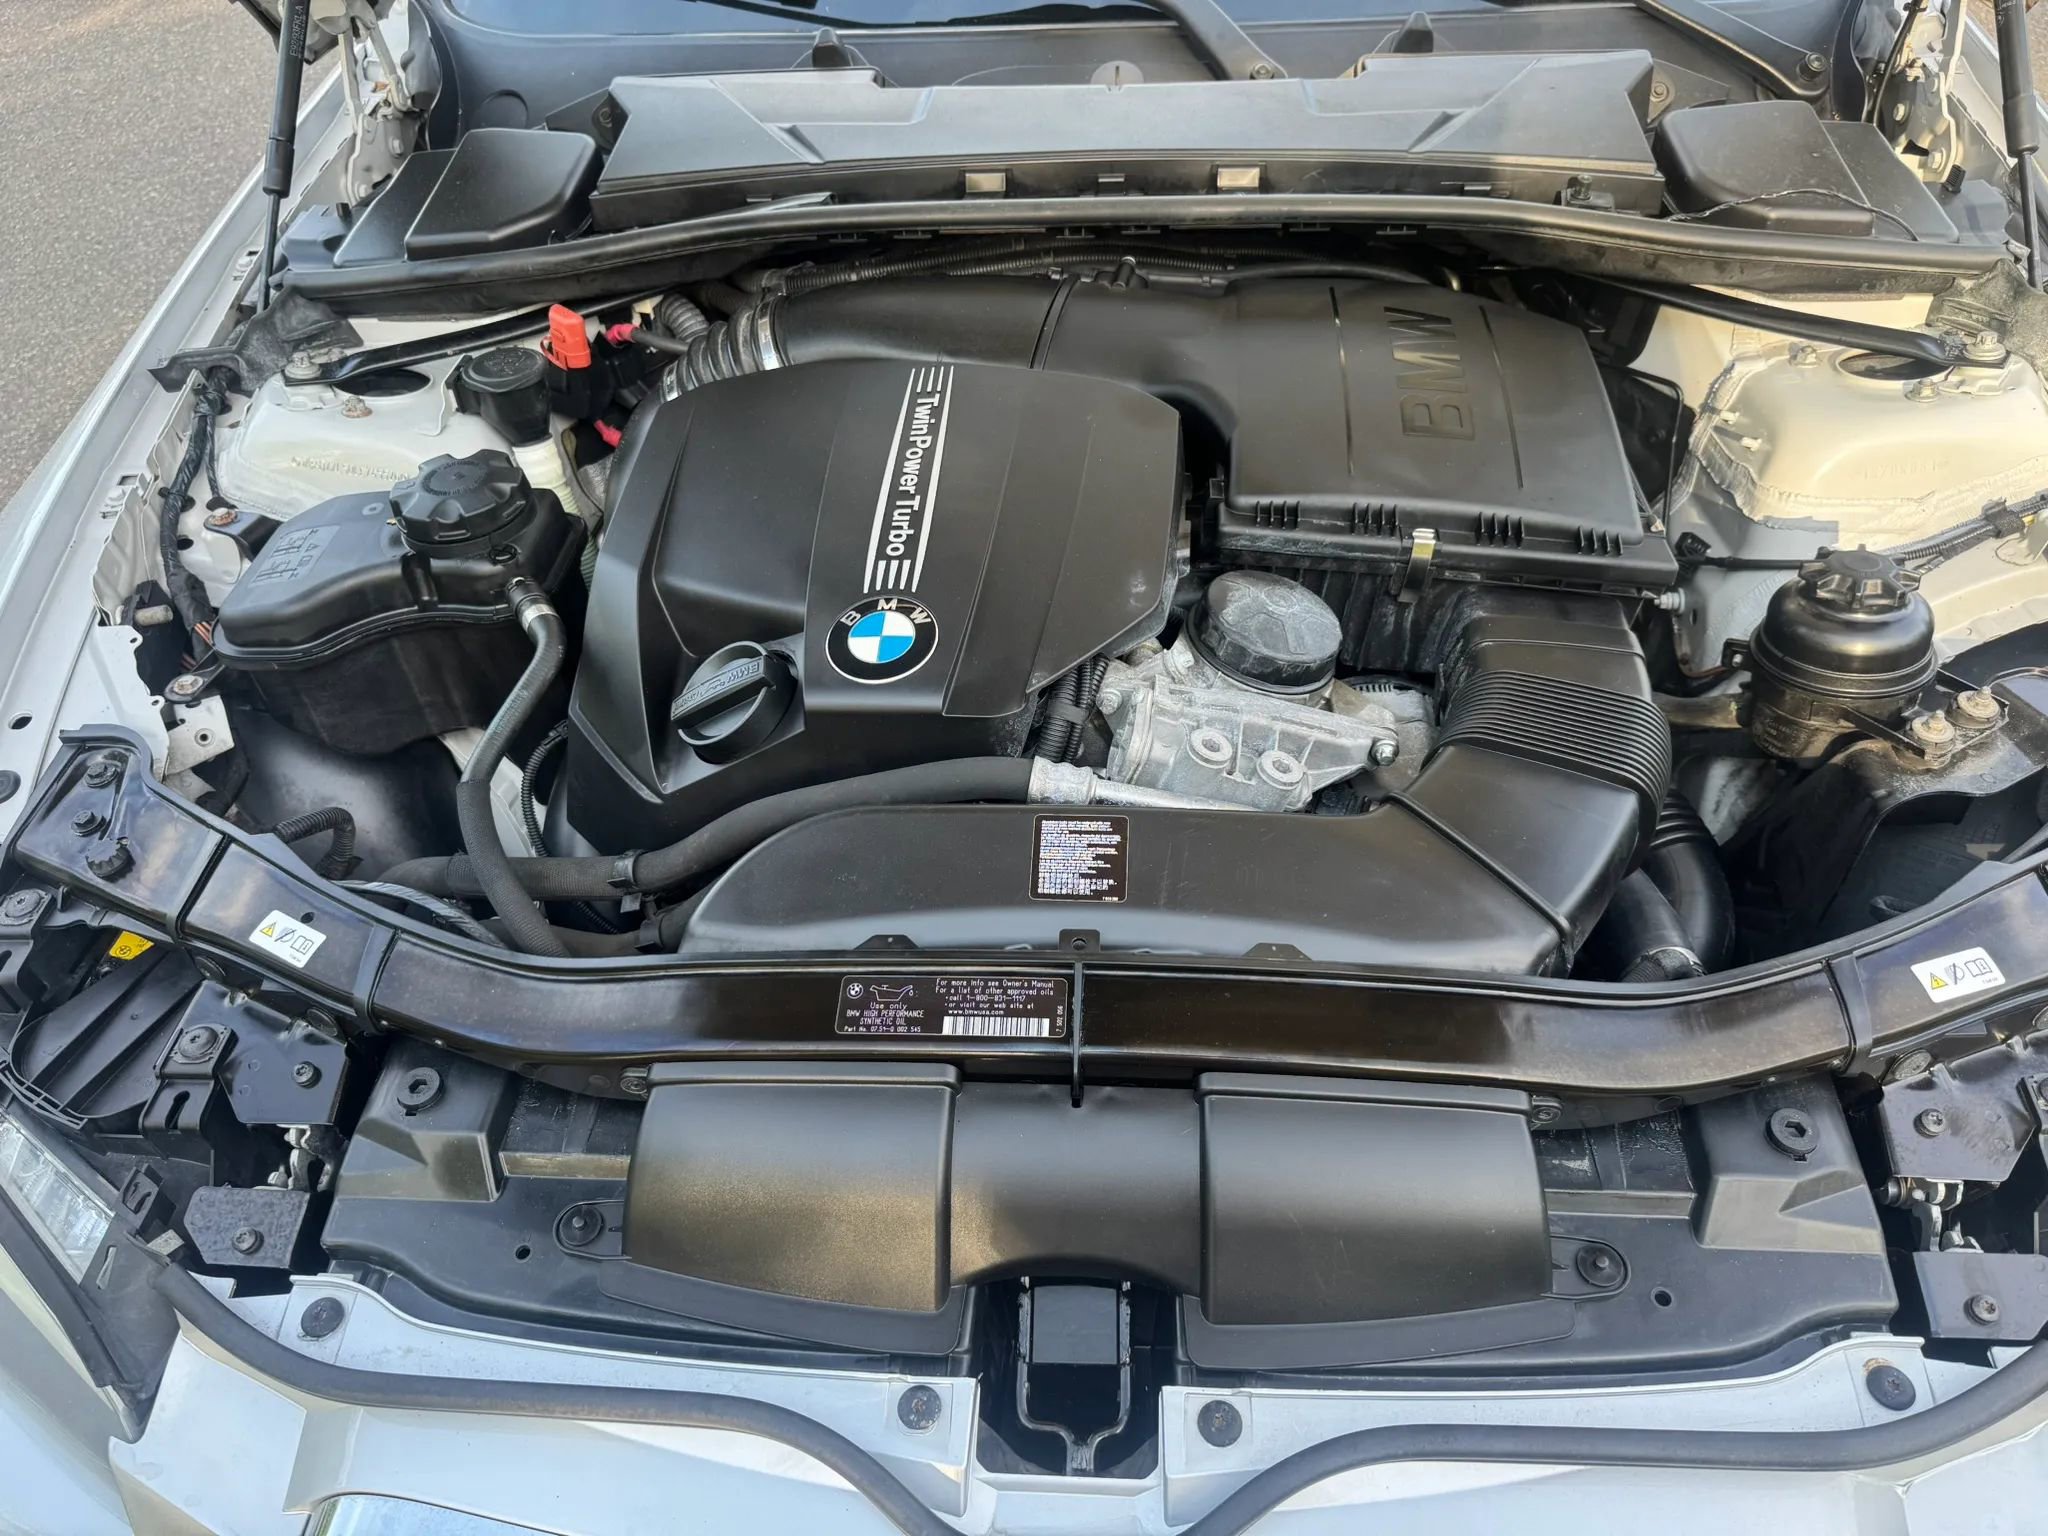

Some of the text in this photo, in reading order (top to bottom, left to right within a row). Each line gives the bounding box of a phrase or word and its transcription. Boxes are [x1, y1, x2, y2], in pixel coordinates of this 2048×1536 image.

[1383, 306, 1475, 442] BMW
[839, 598, 932, 626] BMW
[935, 978, 948, 986] For
[1002, 979, 1028, 987] Owner's
[1031, 980, 1054, 988] Manual
[1007, 988, 1037, 997] approved
[1040, 988, 1054, 996] oils
[889, 1001, 908, 1010] only
[846, 1009, 925, 1018] BMW HIGH PERFORMANCE
[859, 1017, 907, 1025] SYNTHETIC OIL
